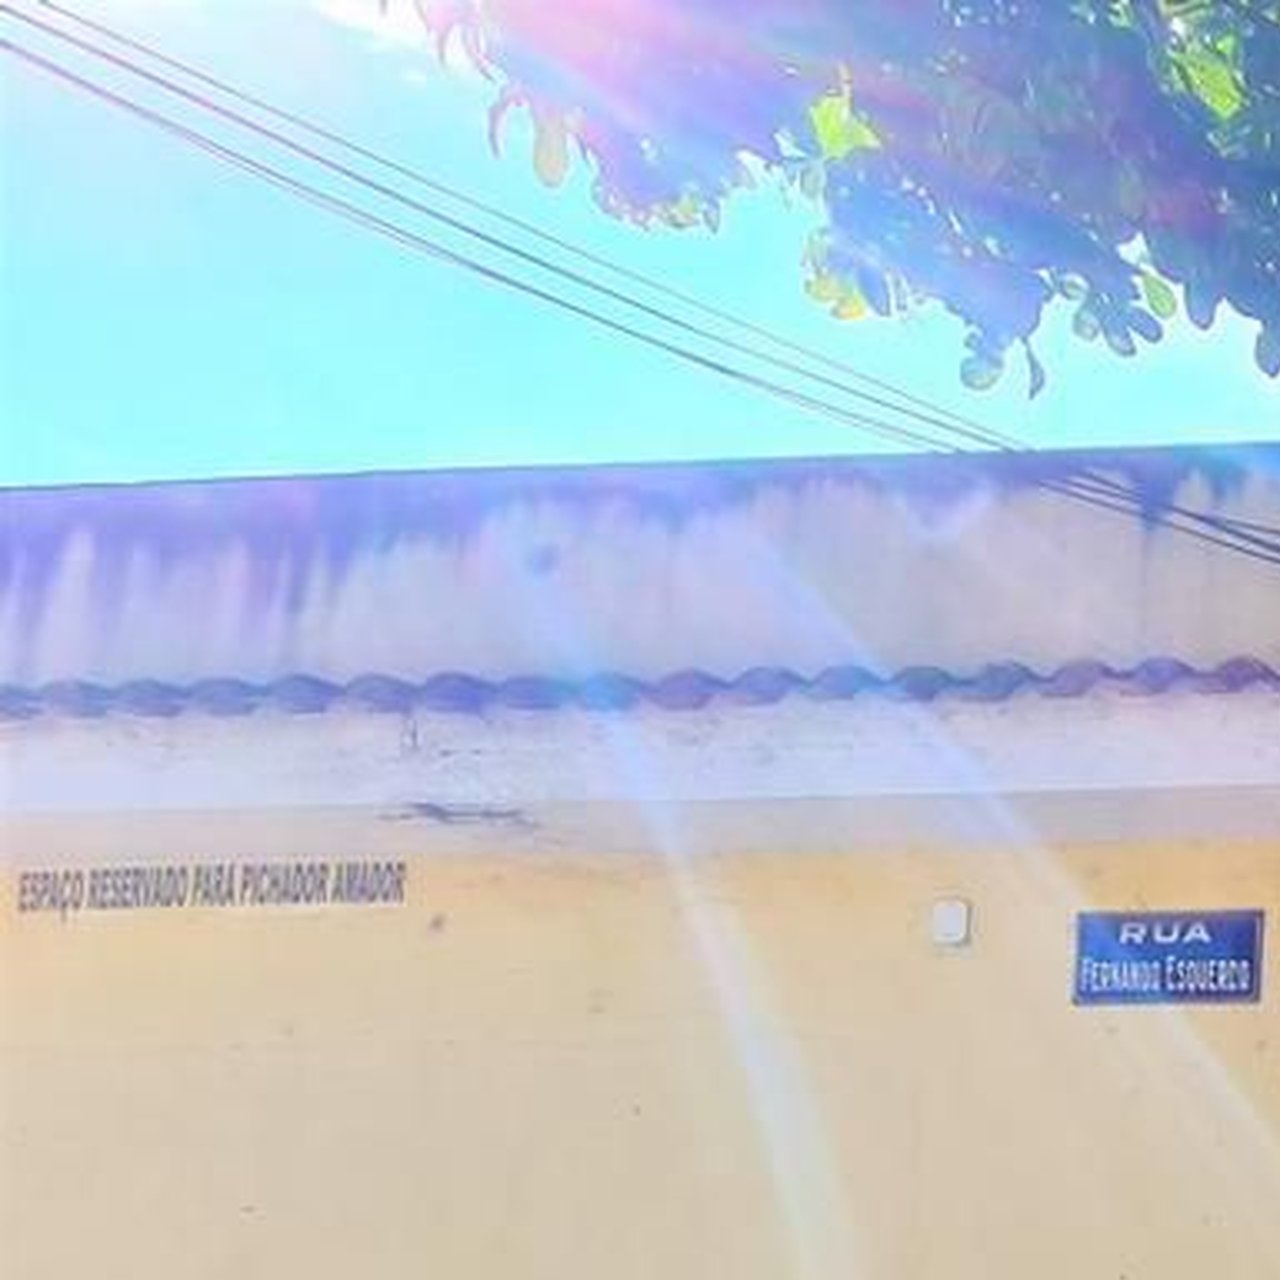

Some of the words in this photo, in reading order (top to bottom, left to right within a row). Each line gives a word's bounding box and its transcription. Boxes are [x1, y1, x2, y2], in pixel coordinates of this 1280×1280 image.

[88, 865, 188, 908] RESERVADO
[191, 863, 236, 907] PARA
[1117, 921, 1213, 944] RUA
